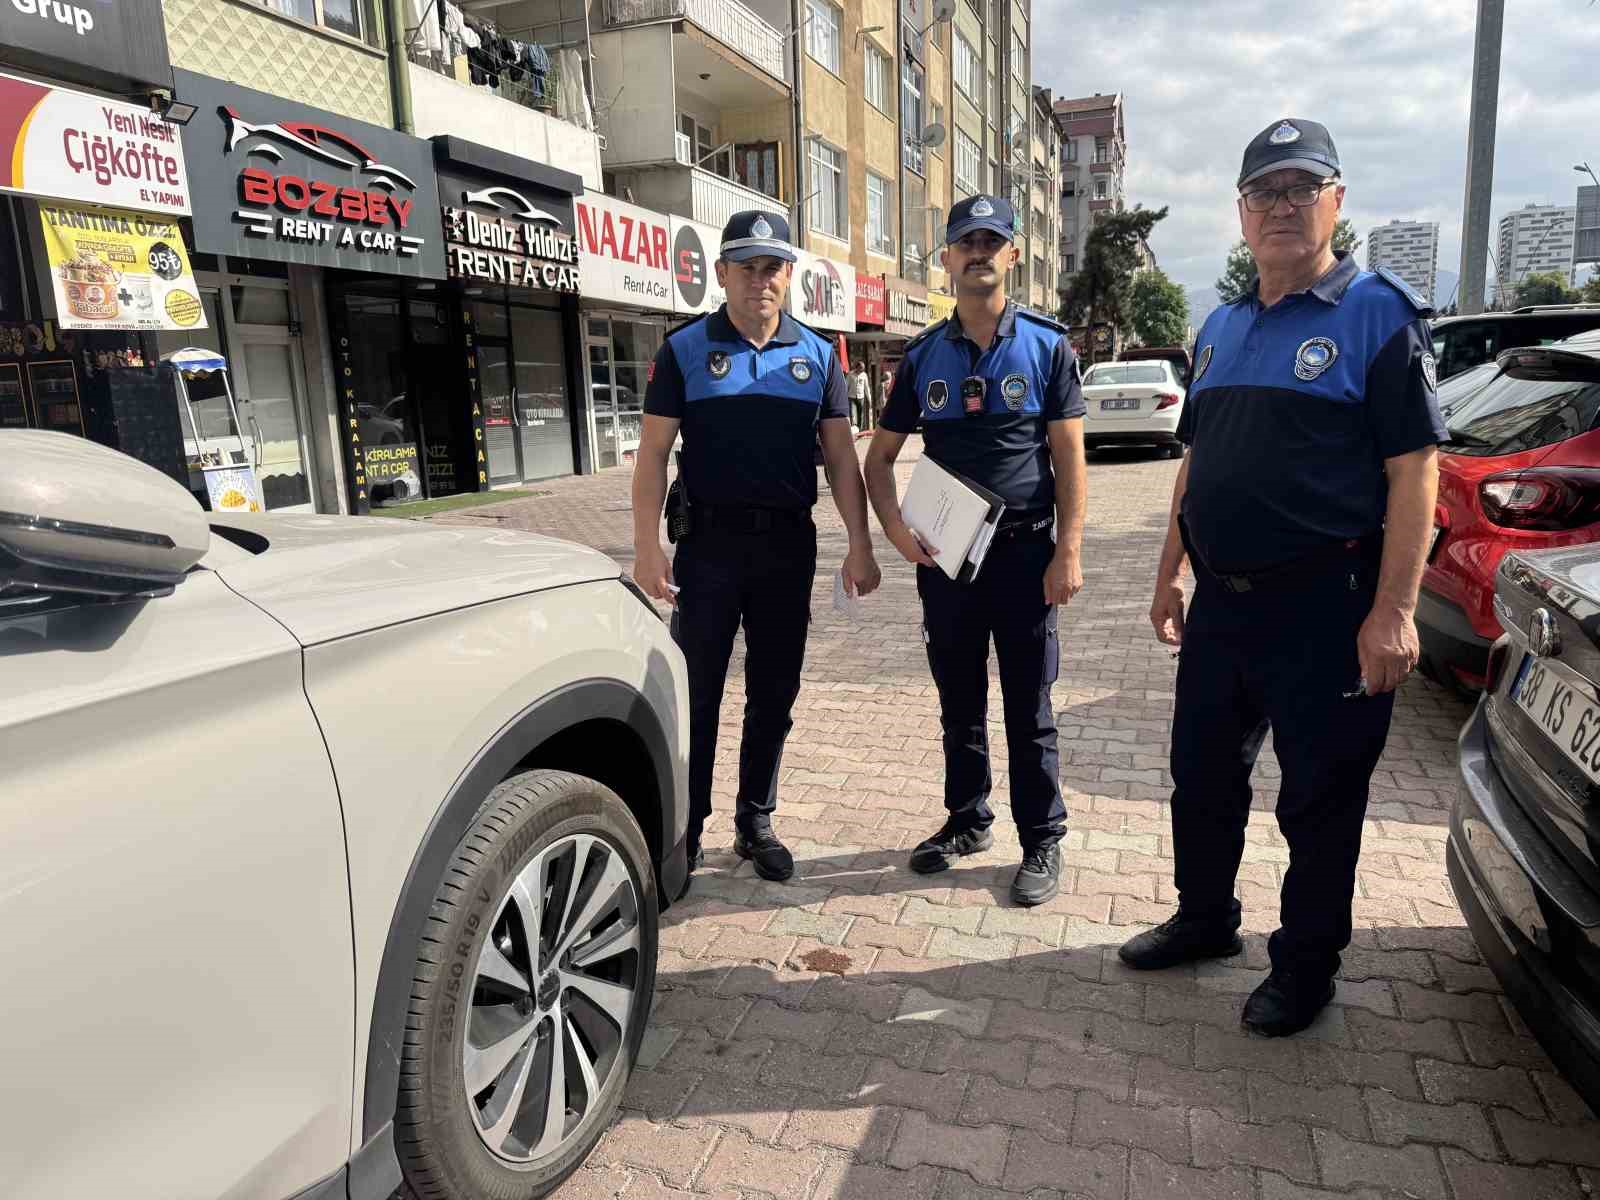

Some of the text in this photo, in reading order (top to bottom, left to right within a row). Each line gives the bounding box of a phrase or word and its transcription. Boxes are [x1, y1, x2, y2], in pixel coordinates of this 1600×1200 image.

[11, 0, 94, 35] Grup
[102, 106, 137, 135] Yeni
[63, 127, 180, 186] Çiğköfte
[140, 188, 184, 207] EL YAPIMI
[241, 168, 413, 229] BOZBEY
[281, 217, 396, 251] RENT A CAR
[466, 210, 518, 251] Deniz
[576, 202, 670, 271] NAZAR
[457, 248, 582, 291] RENT A CAR
[623, 275, 669, 298] Rent A Car
[340, 336, 352, 376] OTO
[472, 402, 480, 416] A
[390, 461, 410, 475] CAR
[475, 428, 487, 484] CAR
[1520, 662, 1545, 710] 38
[1541, 680, 1573, 735] KS
[438, 887, 491, 1043] 235/50 R 19 V
